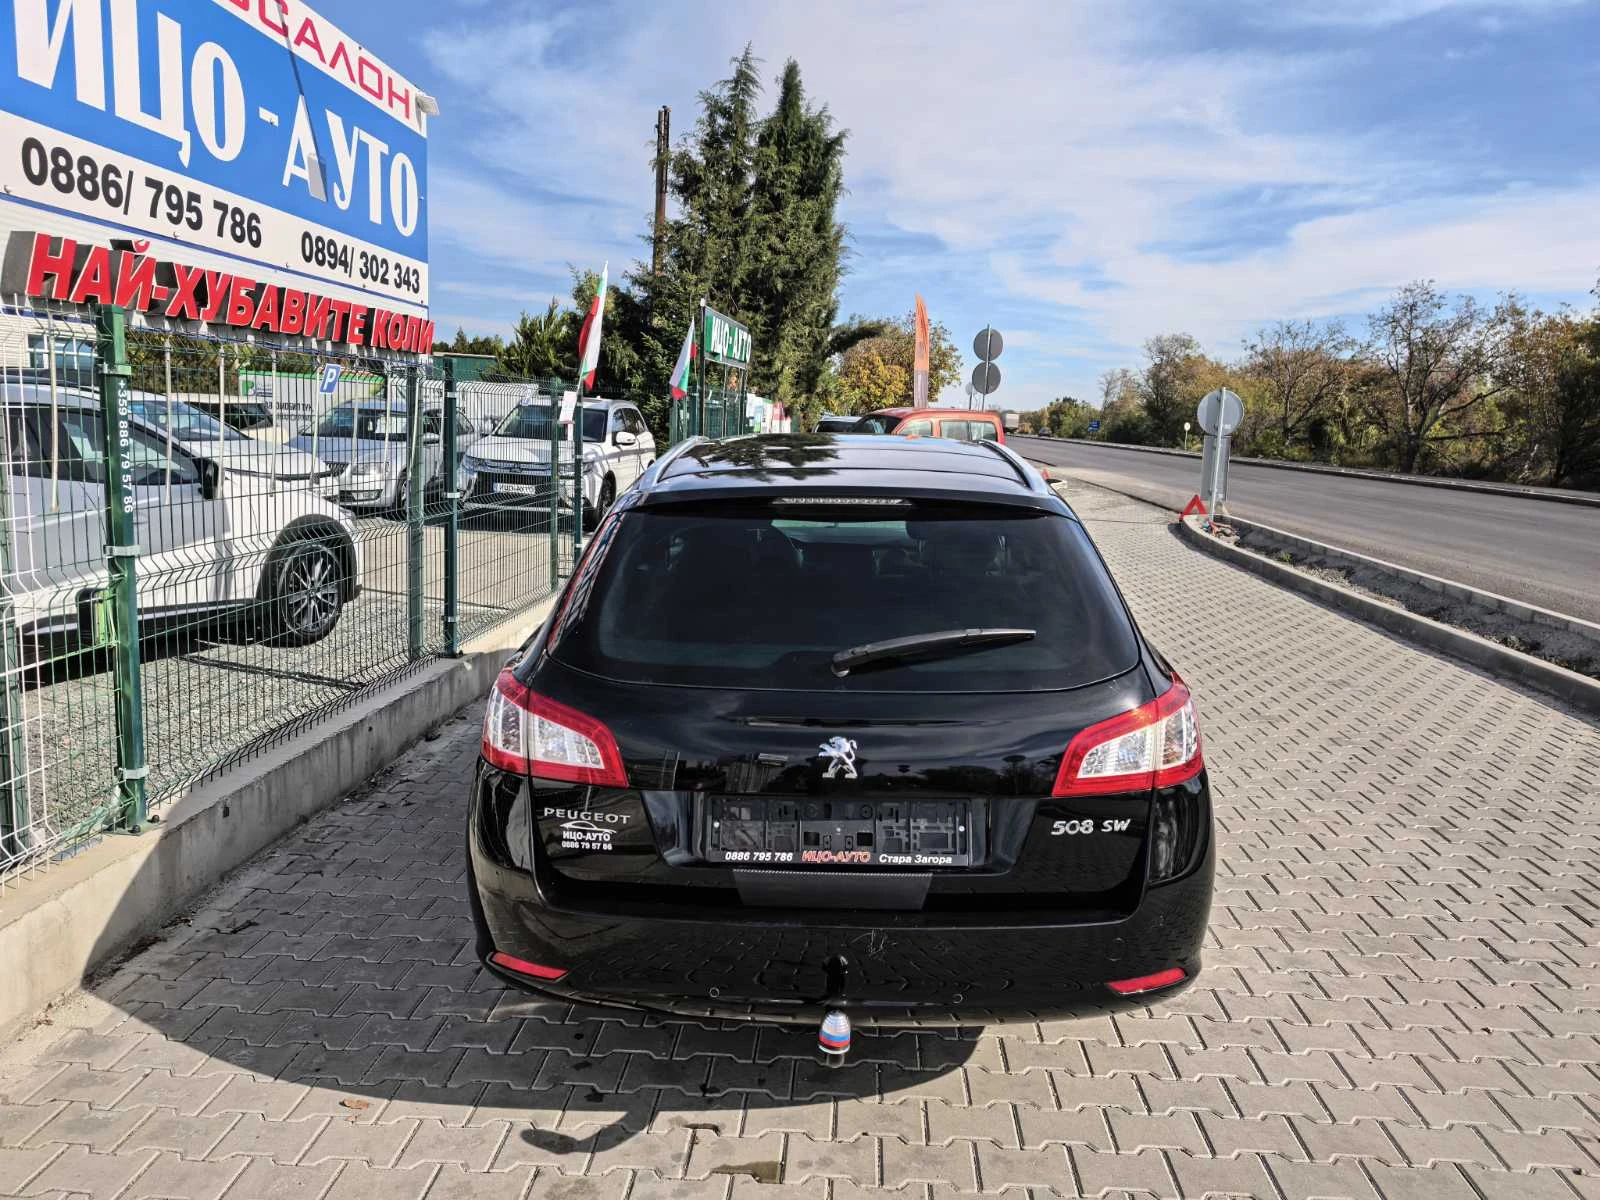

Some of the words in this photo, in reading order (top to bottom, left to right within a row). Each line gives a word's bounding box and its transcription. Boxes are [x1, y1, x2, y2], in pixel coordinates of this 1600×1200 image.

[228, 0, 410, 120] САЛОН
[21, 136, 134, 216] 0886/
[144, 176, 203, 231] 795
[212, 199, 262, 249] 786
[301, 231, 355, 278] 0894/
[359, 251, 390, 285] 302
[394, 262, 420, 294] 343
[25, 232, 369, 346] НАЙ-ХУБАВИТЕ
[370, 308, 436, 355] КОЛИ
[118, 379, 128, 416] +359
[119, 421, 129, 447] 886
[120, 451, 131, 469] 79
[121, 474, 132, 490] 57
[123, 495, 134, 513] 86
[544, 807, 631, 824] PEUGEOT
[1050, 819, 1094, 835] 508
[1101, 818, 1131, 832] SW
[562, 831, 611, 842] ИЦО-АУТО
[580, 842, 591, 850] 79
[591, 842, 601, 850] 57
[725, 851, 750, 861] 0886
[752, 852, 772, 862] 795
[774, 852, 793, 862] 786
[801, 850, 872, 863] ИЦО-АУТО
[879, 854, 912, 864] Стара
[914, 855, 953, 864] Загора
